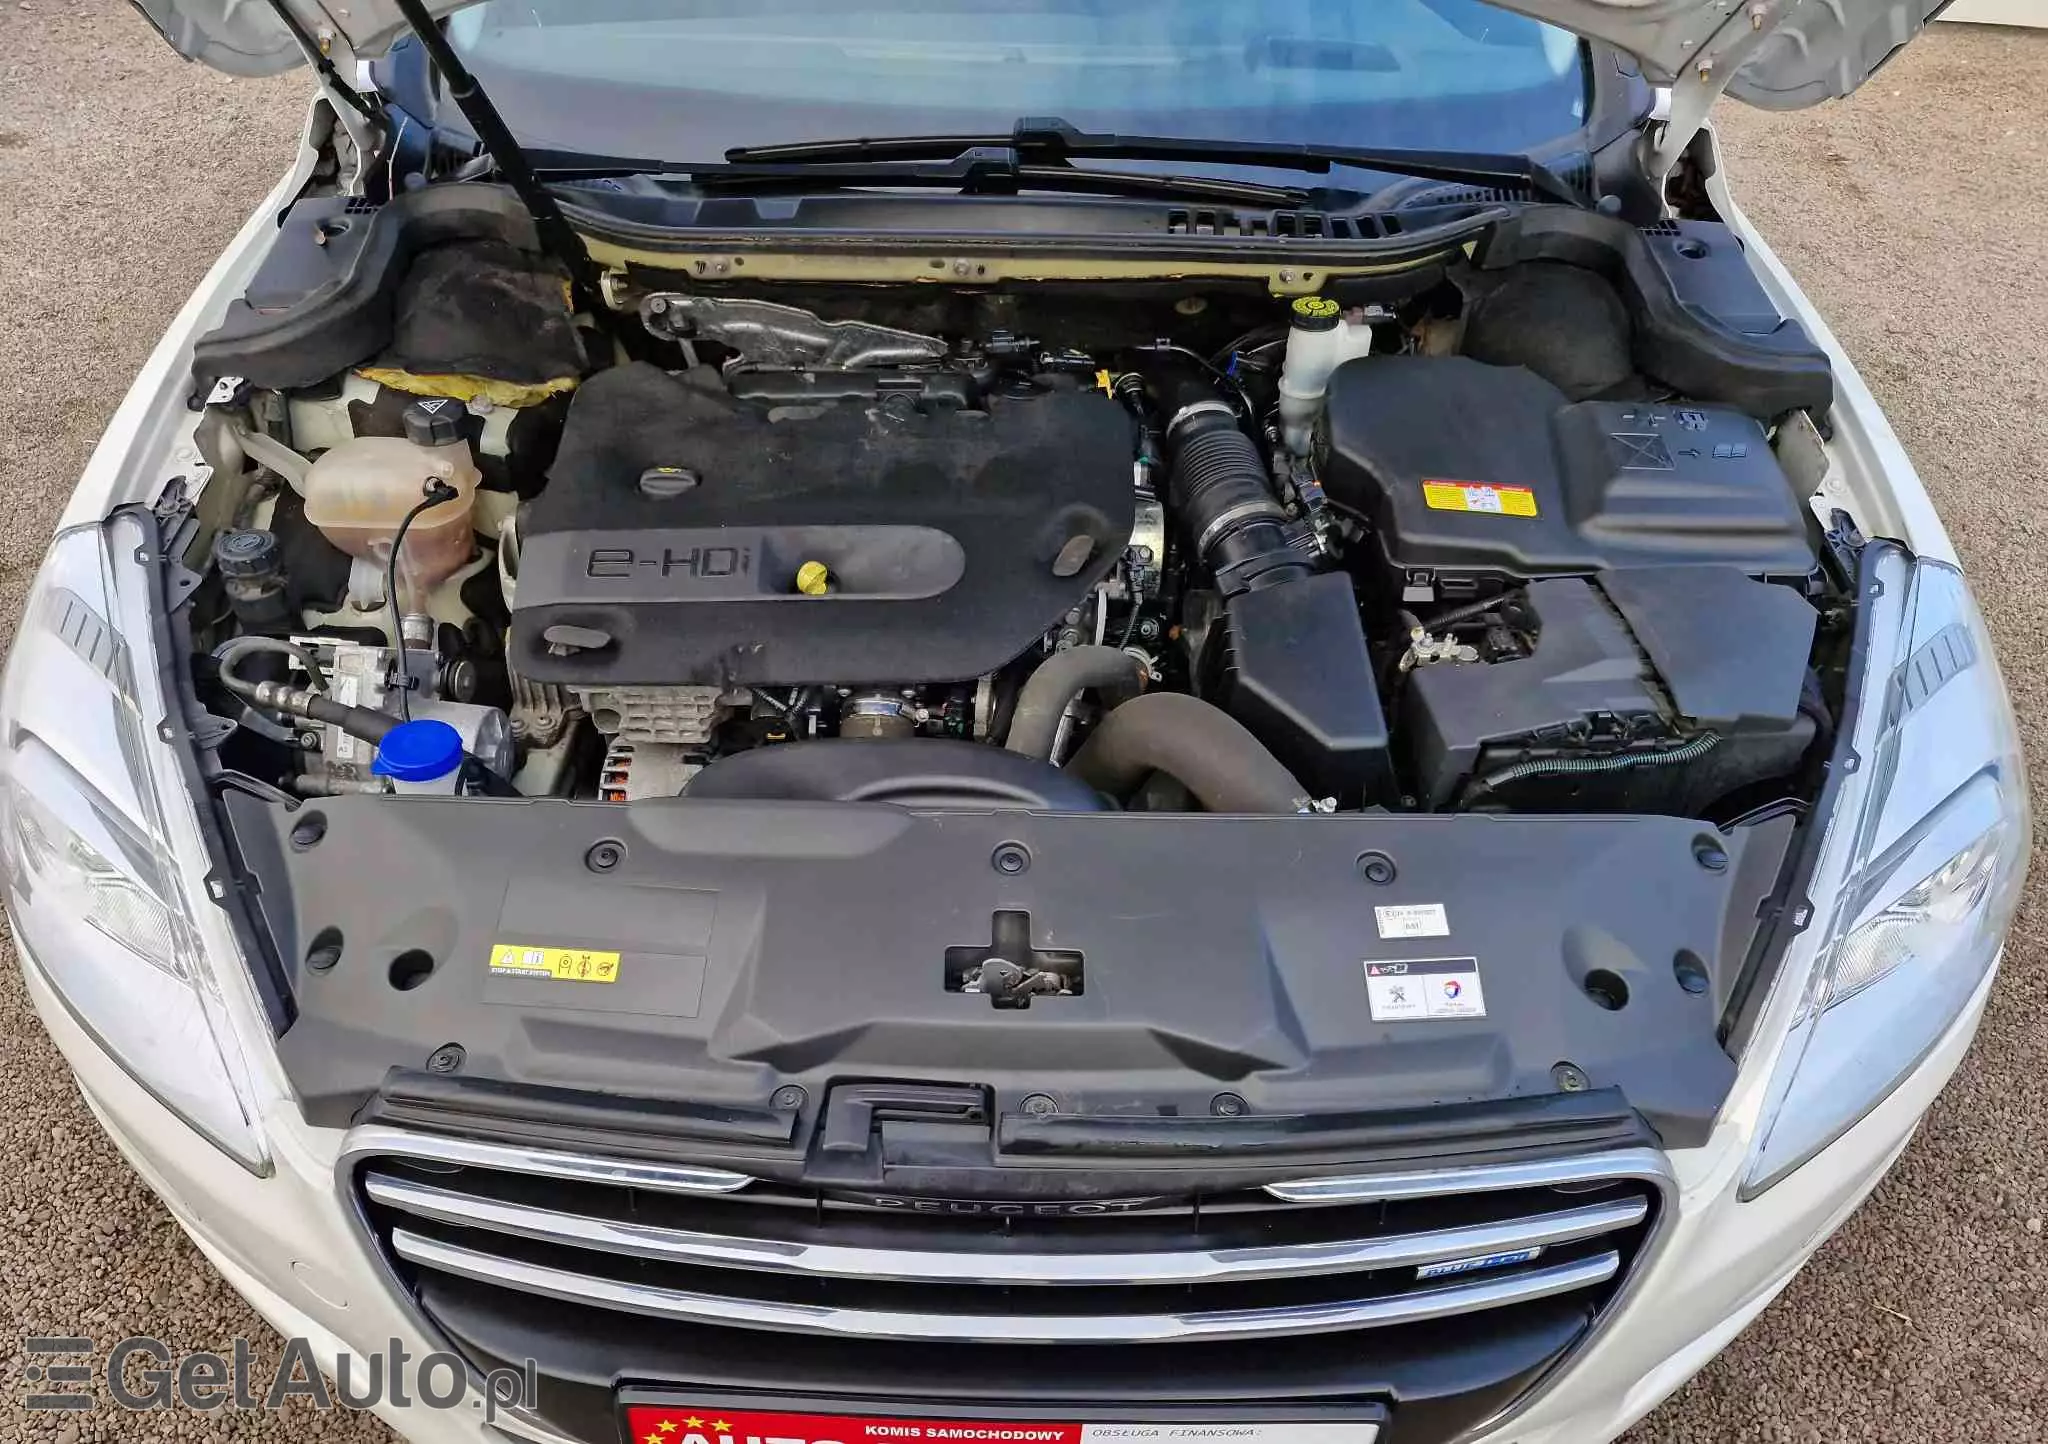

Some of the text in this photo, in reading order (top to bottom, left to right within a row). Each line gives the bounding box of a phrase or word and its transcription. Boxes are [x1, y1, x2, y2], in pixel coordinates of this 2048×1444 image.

[865, 1425, 1064, 1440] KOMIS SAMOCHODOWY
[1092, 1429, 1159, 1437] OBSŁUGA
